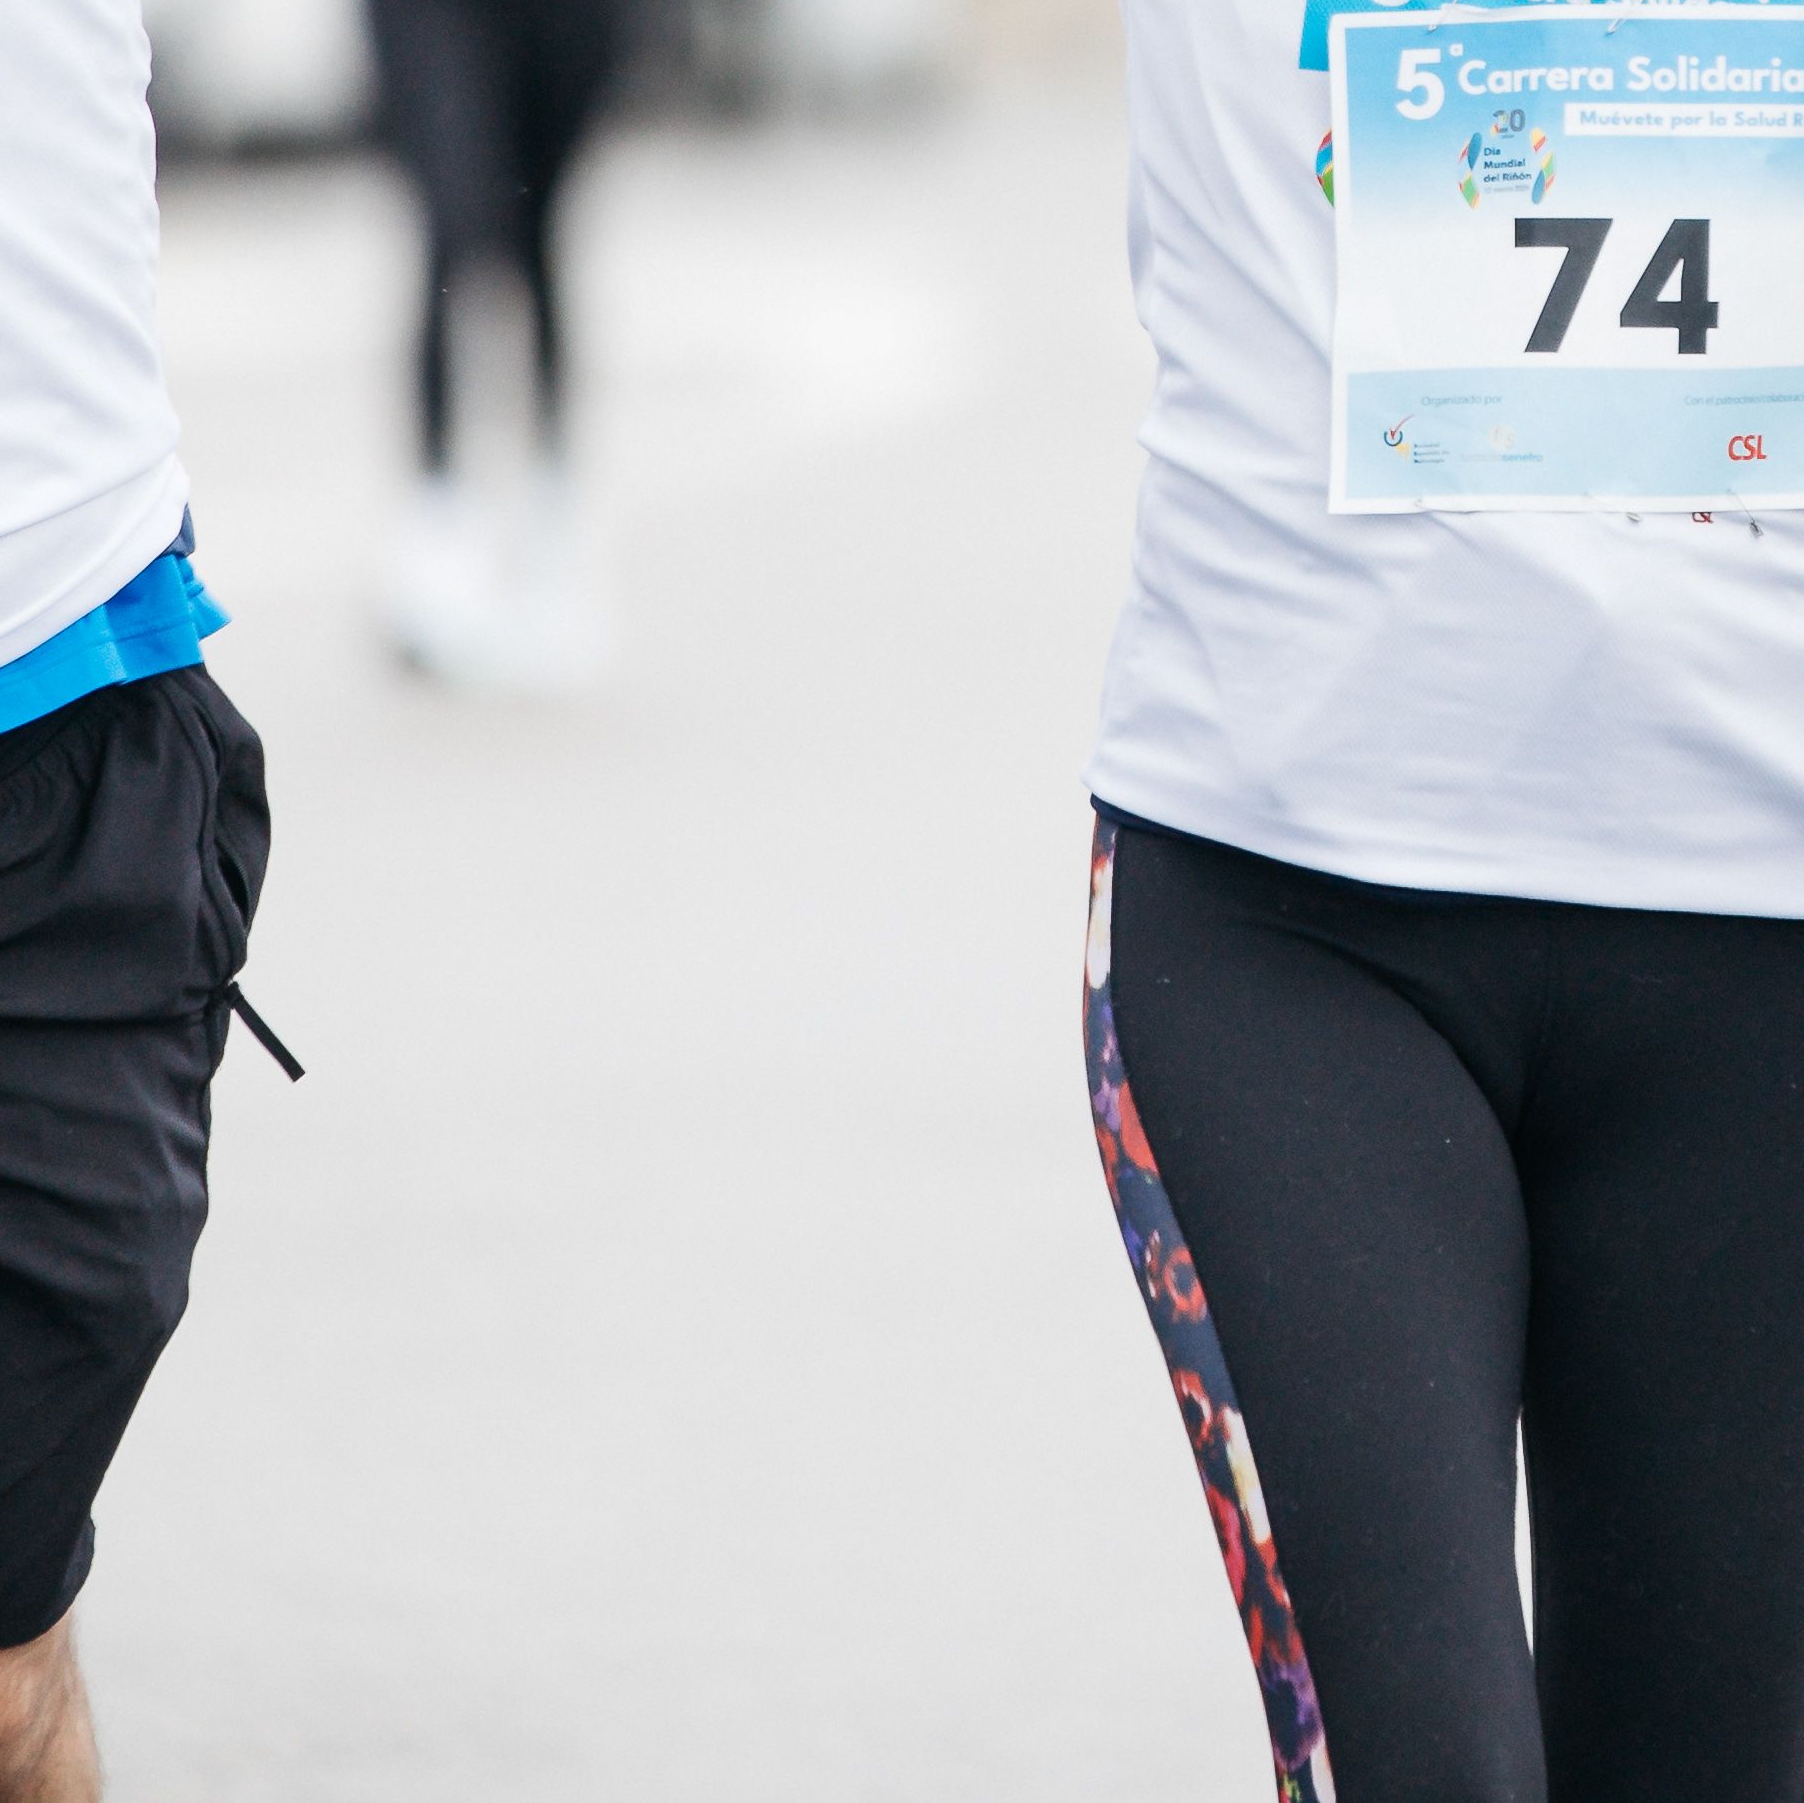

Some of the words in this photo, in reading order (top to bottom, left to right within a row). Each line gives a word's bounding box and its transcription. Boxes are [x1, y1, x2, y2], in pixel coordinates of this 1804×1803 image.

[1458, 59, 1614, 95] Carrera
[1580, 109, 1664, 127] Muévete
[1671, 113, 1701, 130] por
[1710, 110, 1727, 127] la
[1734, 110, 1786, 127] Salud
[1484, 158, 1525, 169] Mundial
[1515, 218, 1719, 354] 74
[1728, 435, 1767, 460] CSL
